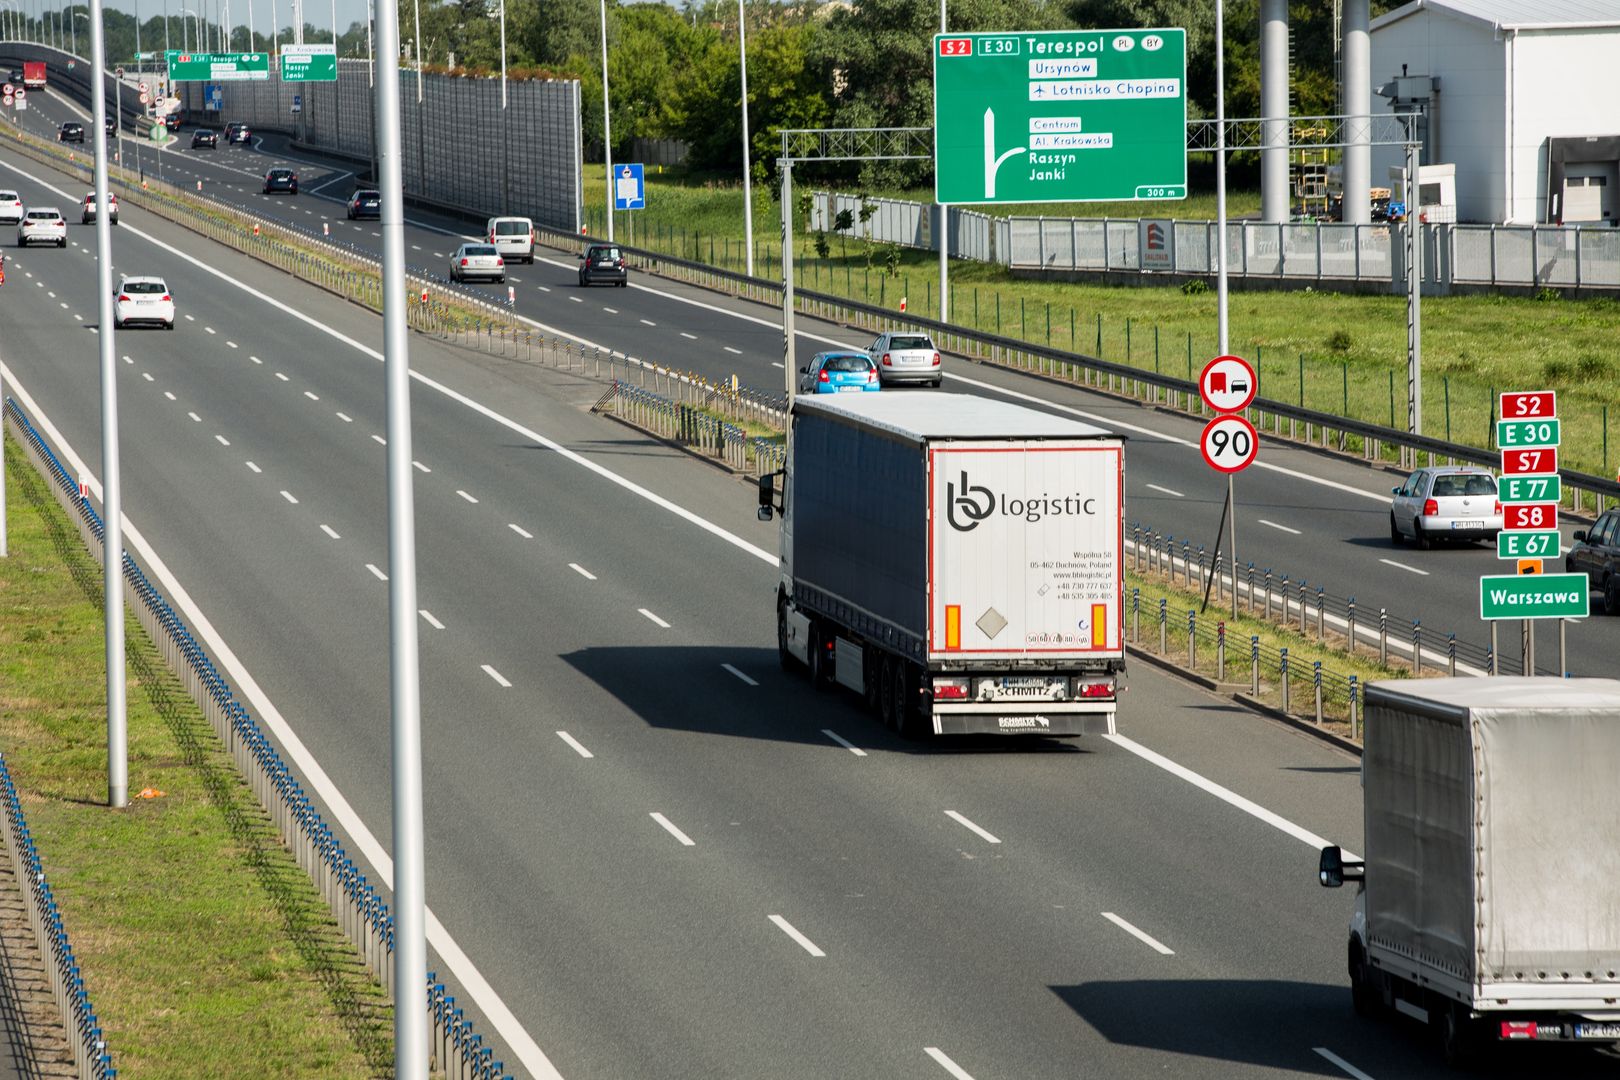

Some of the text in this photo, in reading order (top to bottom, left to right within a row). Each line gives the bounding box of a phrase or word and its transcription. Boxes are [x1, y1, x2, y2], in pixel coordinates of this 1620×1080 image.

[985, 40, 1013, 53] E 30
[1026, 37, 1104, 56] Terespol
[1118, 39, 1129, 48] PL
[1146, 38, 1159, 47] BY
[1035, 62, 1091, 76] Ursynów
[1053, 82, 1175, 96] Lotnisko Chopina
[1034, 120, 1079, 130] Centrum
[1034, 136, 1111, 146] Al. Krakowska
[1029, 151, 1076, 166] Raszyn
[1029, 167, 1066, 181] Janki
[1147, 188, 1176, 197] 300 m
[1515, 396, 1542, 416] S2
[1505, 423, 1551, 443] E 30
[1211, 429, 1250, 457] 90
[1518, 452, 1543, 471] S7
[1509, 479, 1549, 499] E 77
[1001, 492, 1096, 523] logistic
[1517, 507, 1544, 526] S8
[1508, 534, 1550, 554] E 67
[1089, 560, 1112, 569] Poland
[1490, 589, 1580, 605] Warszawa
[997, 687, 1050, 697] SCHMITZ
